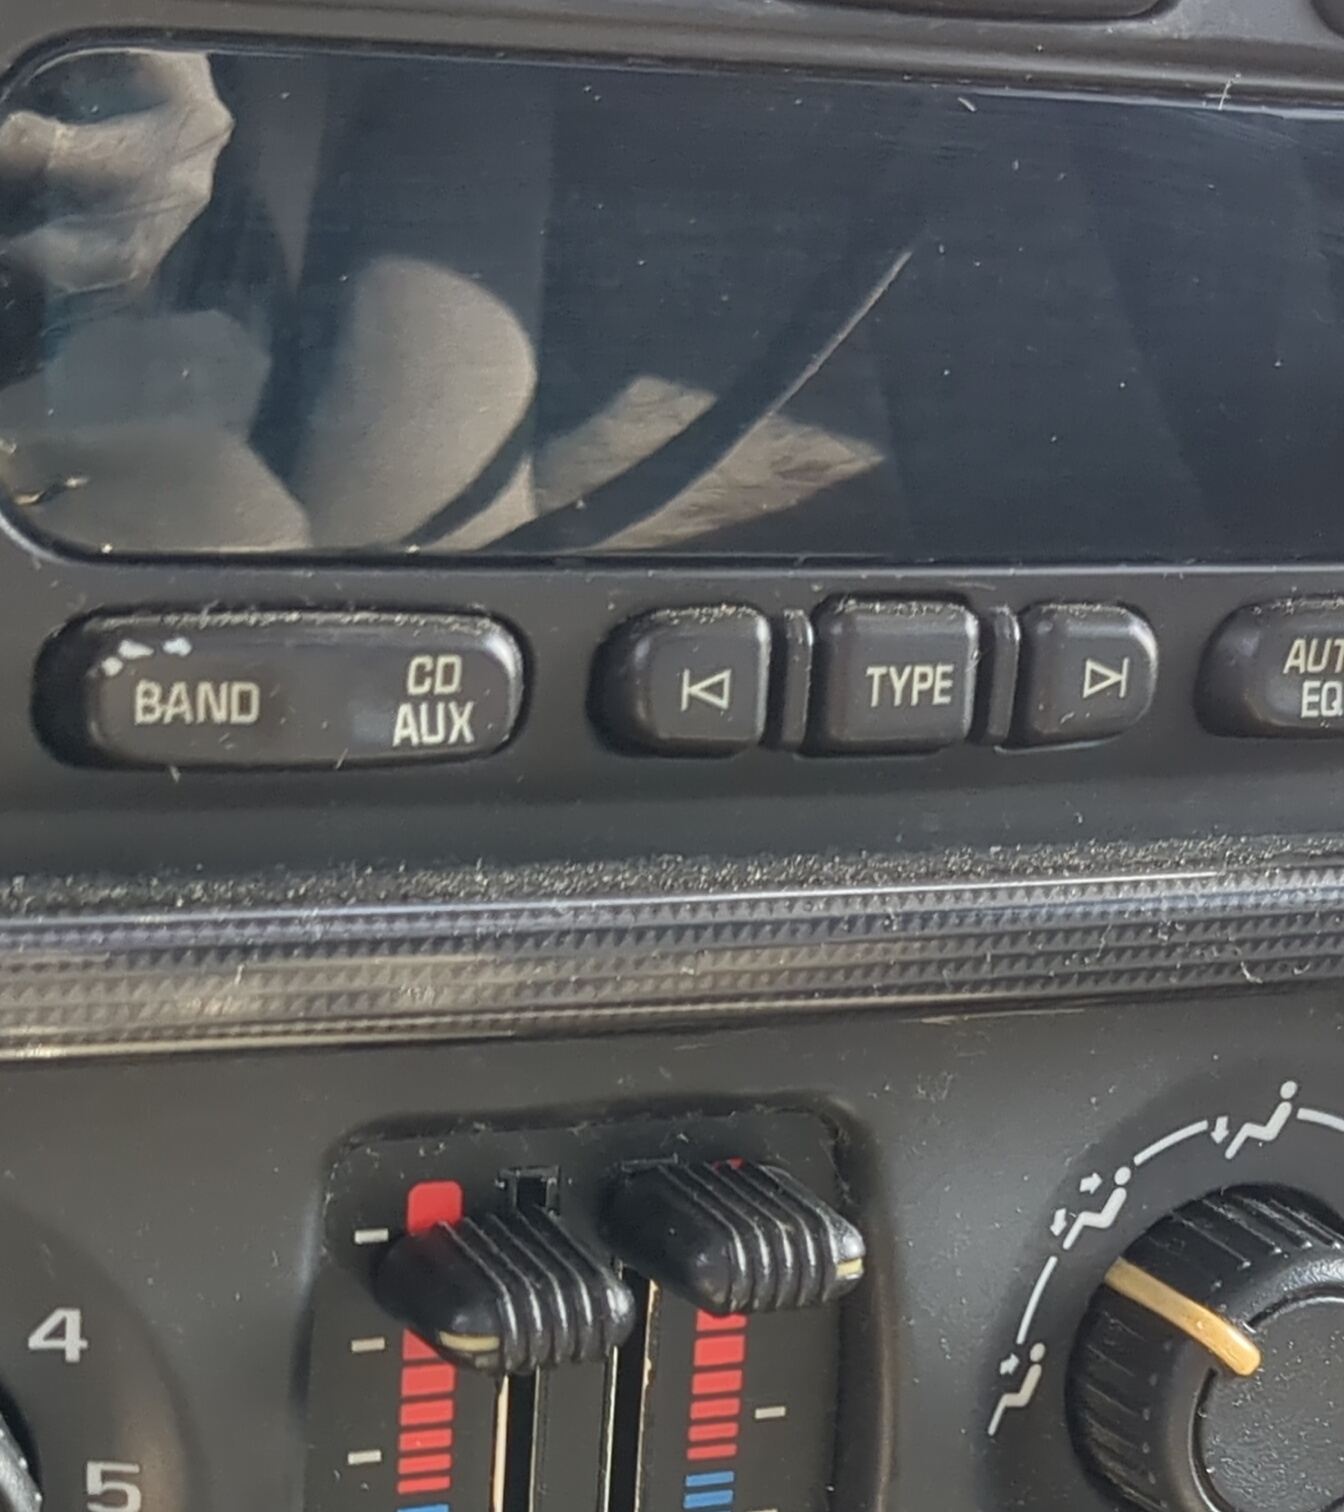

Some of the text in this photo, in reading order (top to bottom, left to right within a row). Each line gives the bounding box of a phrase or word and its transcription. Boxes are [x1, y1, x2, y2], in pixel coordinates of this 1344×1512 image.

[406, 654, 463, 696] CD
[866, 664, 954, 708] TYPE
[134, 679, 260, 725] BAND
[1301, 680, 1344, 718] EQ
[392, 701, 475, 747] AUX
[27, 1307, 88, 1363] 4
